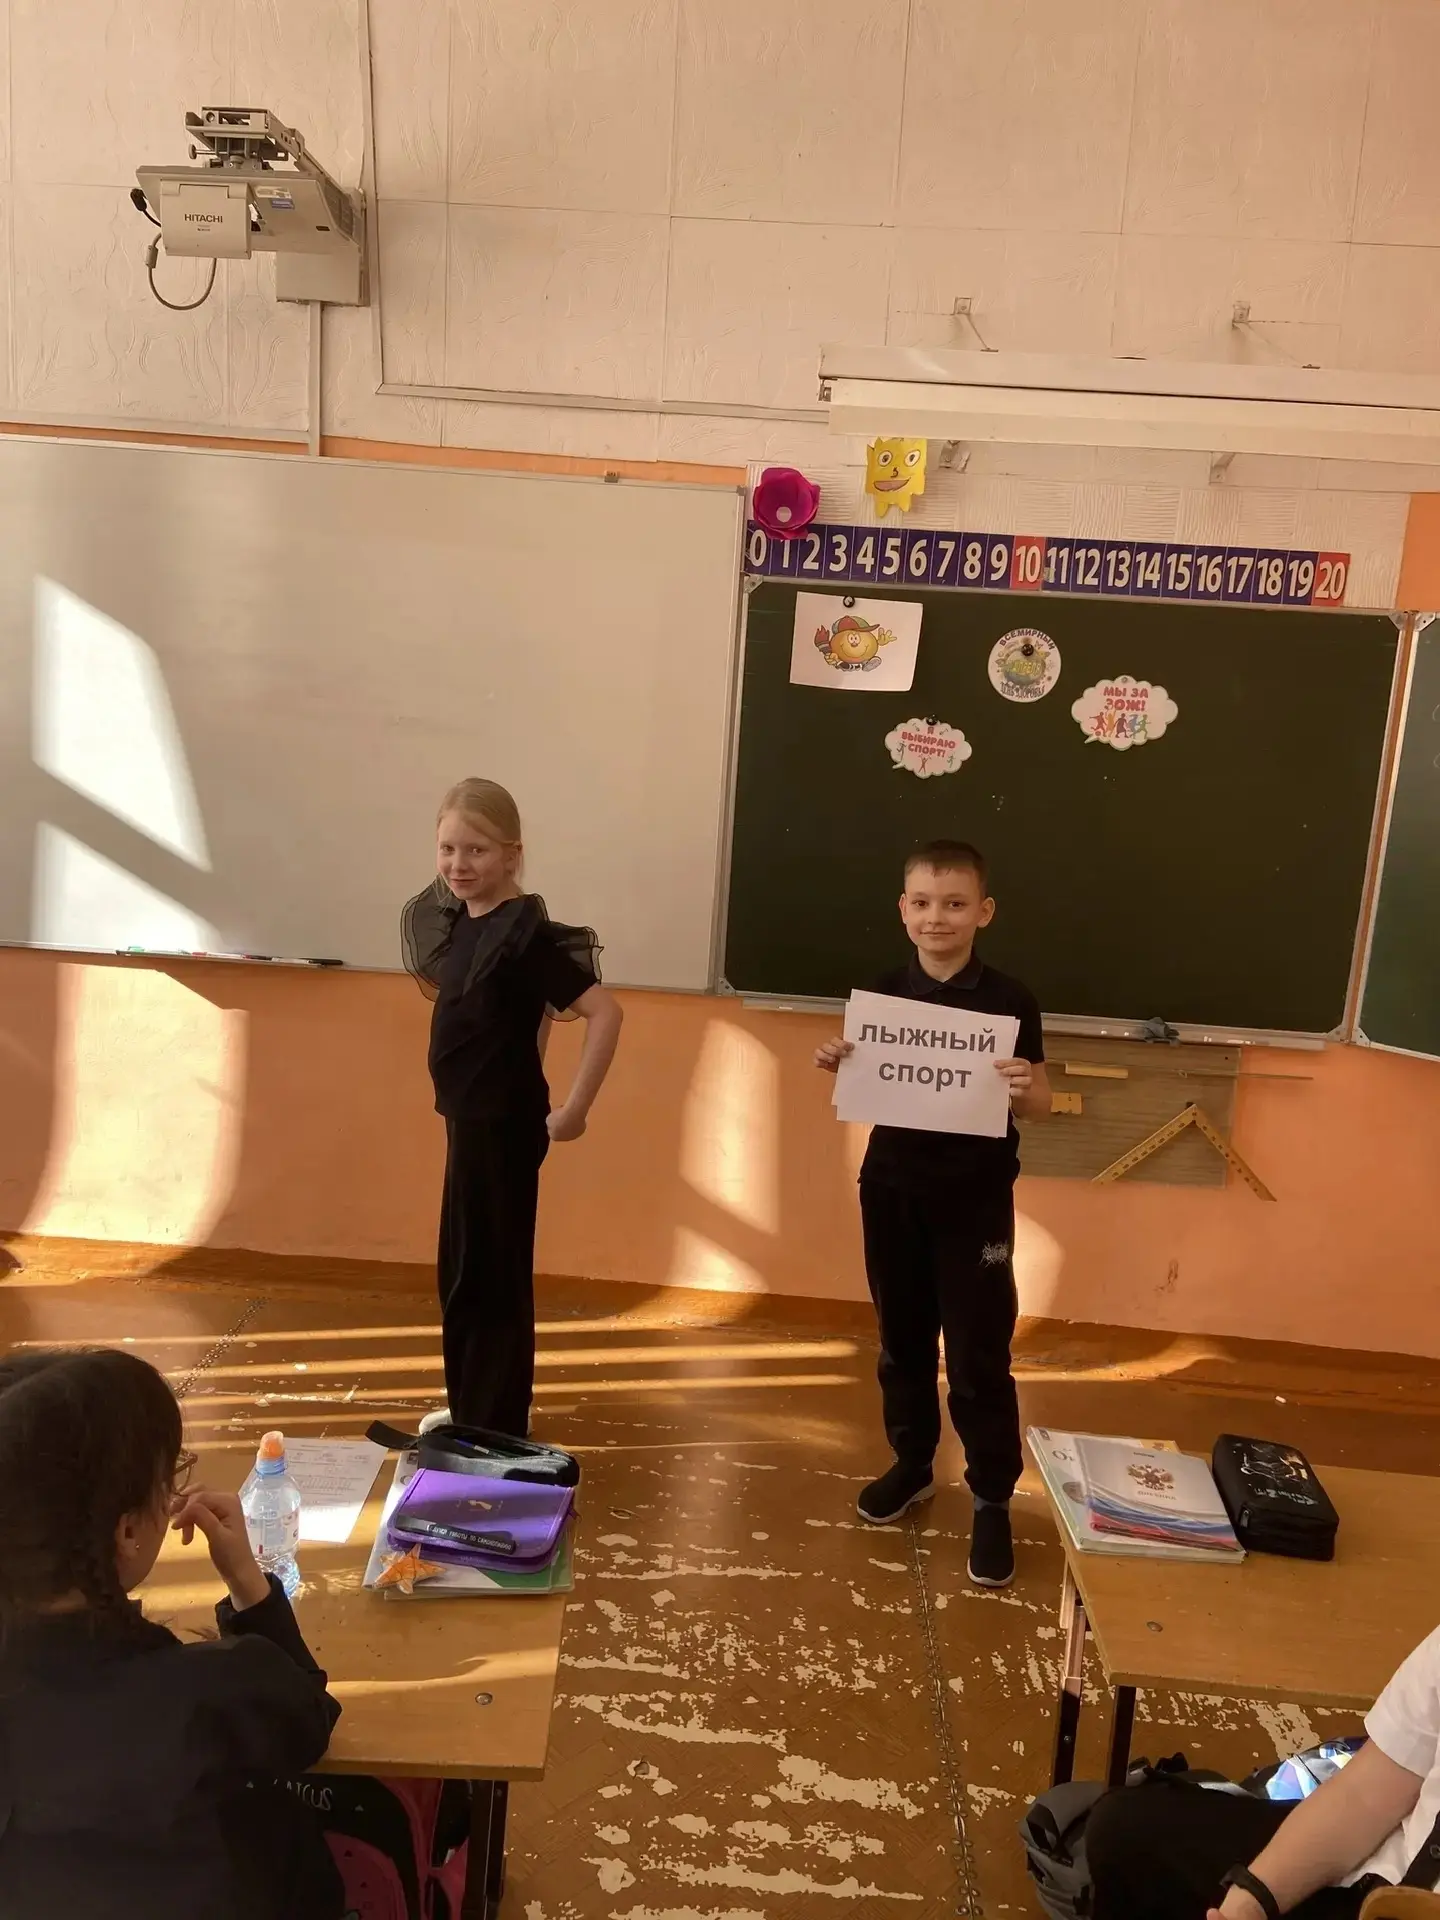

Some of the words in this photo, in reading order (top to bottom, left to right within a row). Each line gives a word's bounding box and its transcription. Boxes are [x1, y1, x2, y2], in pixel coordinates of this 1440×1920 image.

[184, 213, 223, 223] HITACHI
[750, 529, 767, 567] 0
[780, 539, 791, 568] 1
[803, 533, 821, 570] 2
[829, 534, 848, 572] 3
[857, 536, 875, 573] 4
[882, 538, 902, 575] 5
[909, 539, 928, 577] 6
[937, 541, 956, 578] 7
[963, 542, 982, 580] 8
[990, 543, 1009, 581] 9
[1016, 545, 1042, 583] 10
[1046, 546, 1071, 584] 11
[1075, 547, 1101, 586] 12
[1106, 549, 1131, 588] 13
[1136, 551, 1161, 589] 14
[1166, 552, 1192, 591] 15
[1196, 553, 1223, 593] 16
[1227, 555, 1254, 594] 17
[1257, 557, 1283, 596] 18
[1288, 559, 1314, 598] 19
[1315, 560, 1346, 599] 20
[1103, 686, 1127, 697] МЫ
[1130, 687, 1149, 699] ЗА
[1106, 698, 1146, 712] ЗОЖ!
[927, 726, 935, 735] Я
[901, 731, 956, 749] ВЫБИРАЮ
[908, 743, 946, 758] СПОРТ!
[858, 1023, 996, 1053] лыжный
[879, 1062, 972, 1092] спорт
